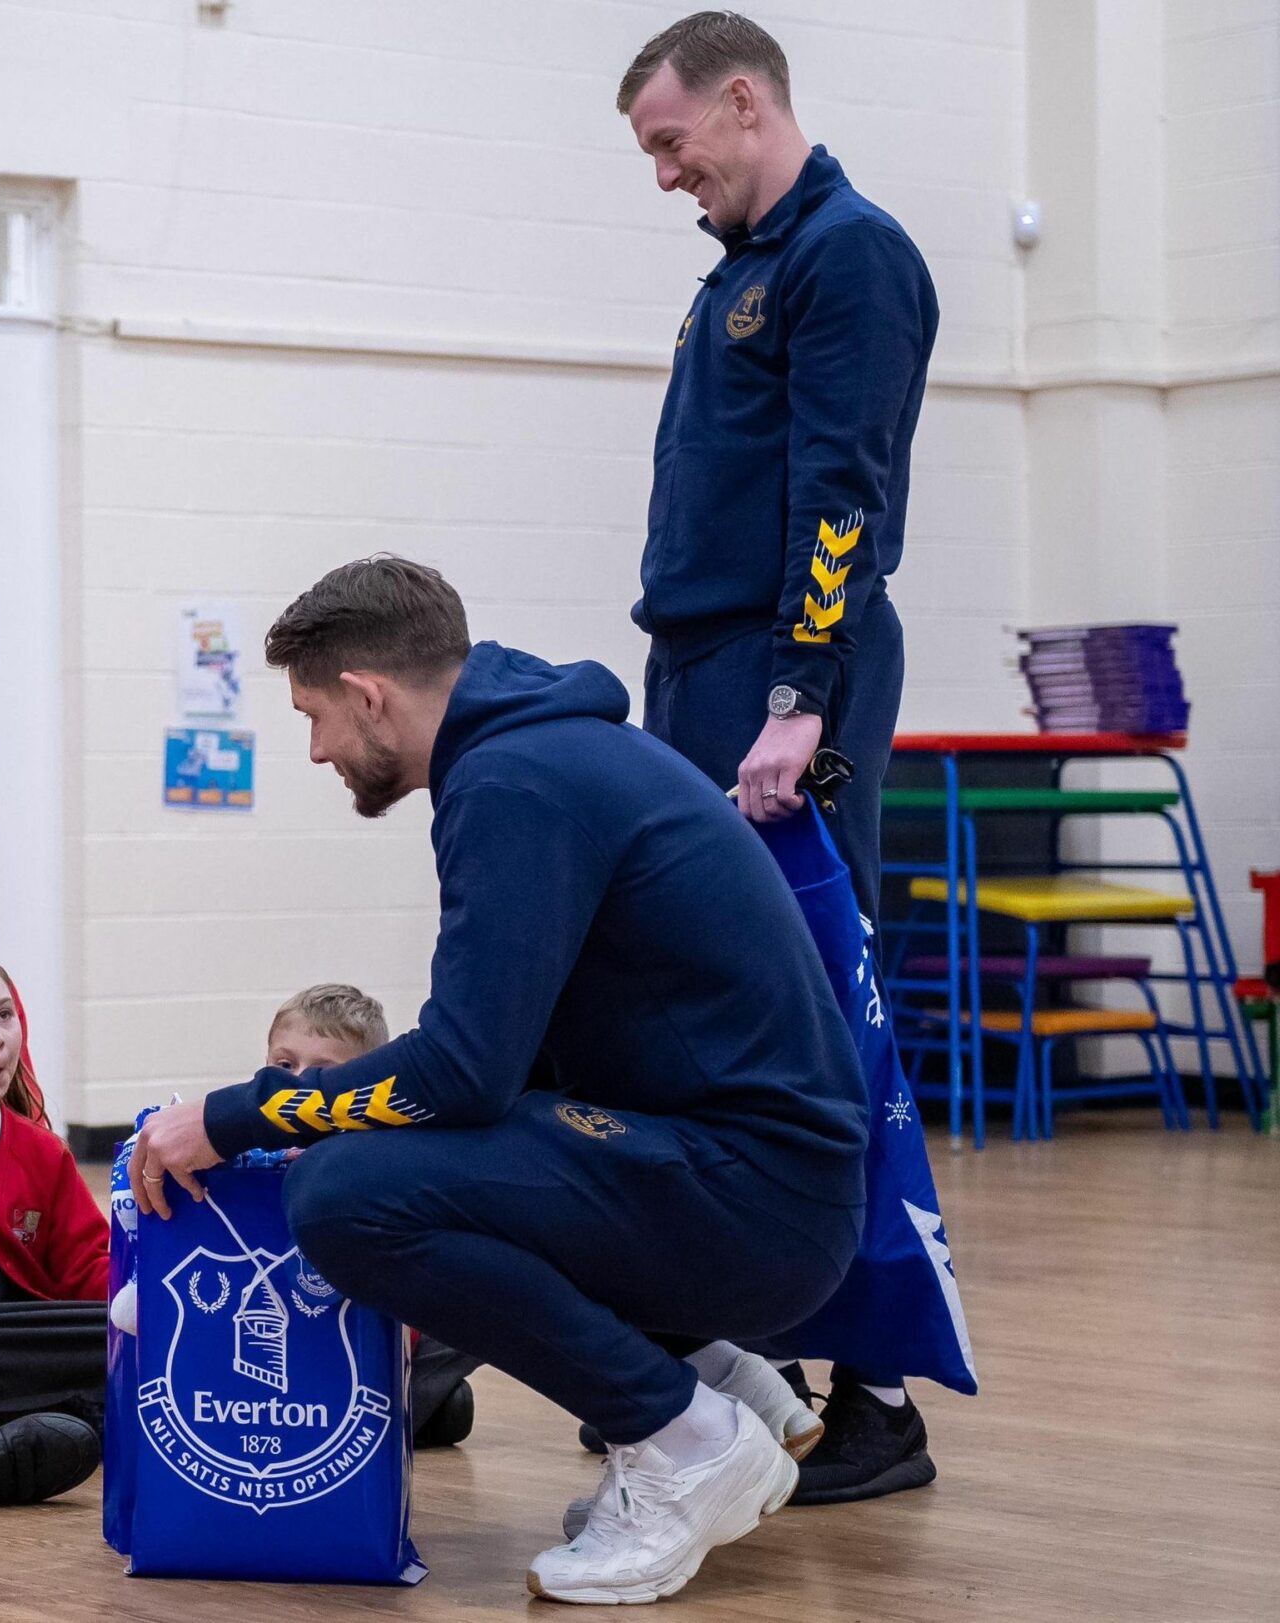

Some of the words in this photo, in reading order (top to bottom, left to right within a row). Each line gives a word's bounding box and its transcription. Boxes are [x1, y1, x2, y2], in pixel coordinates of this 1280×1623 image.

[193, 1390, 328, 1428] Everton
[149, 1416, 179, 1454] NIL
[177, 1451, 232, 1492] SATIS
[238, 1481, 286, 1499] NISI
[292, 1426, 376, 1494] OPTIMUM
[239, 1434, 282, 1455] 1878
